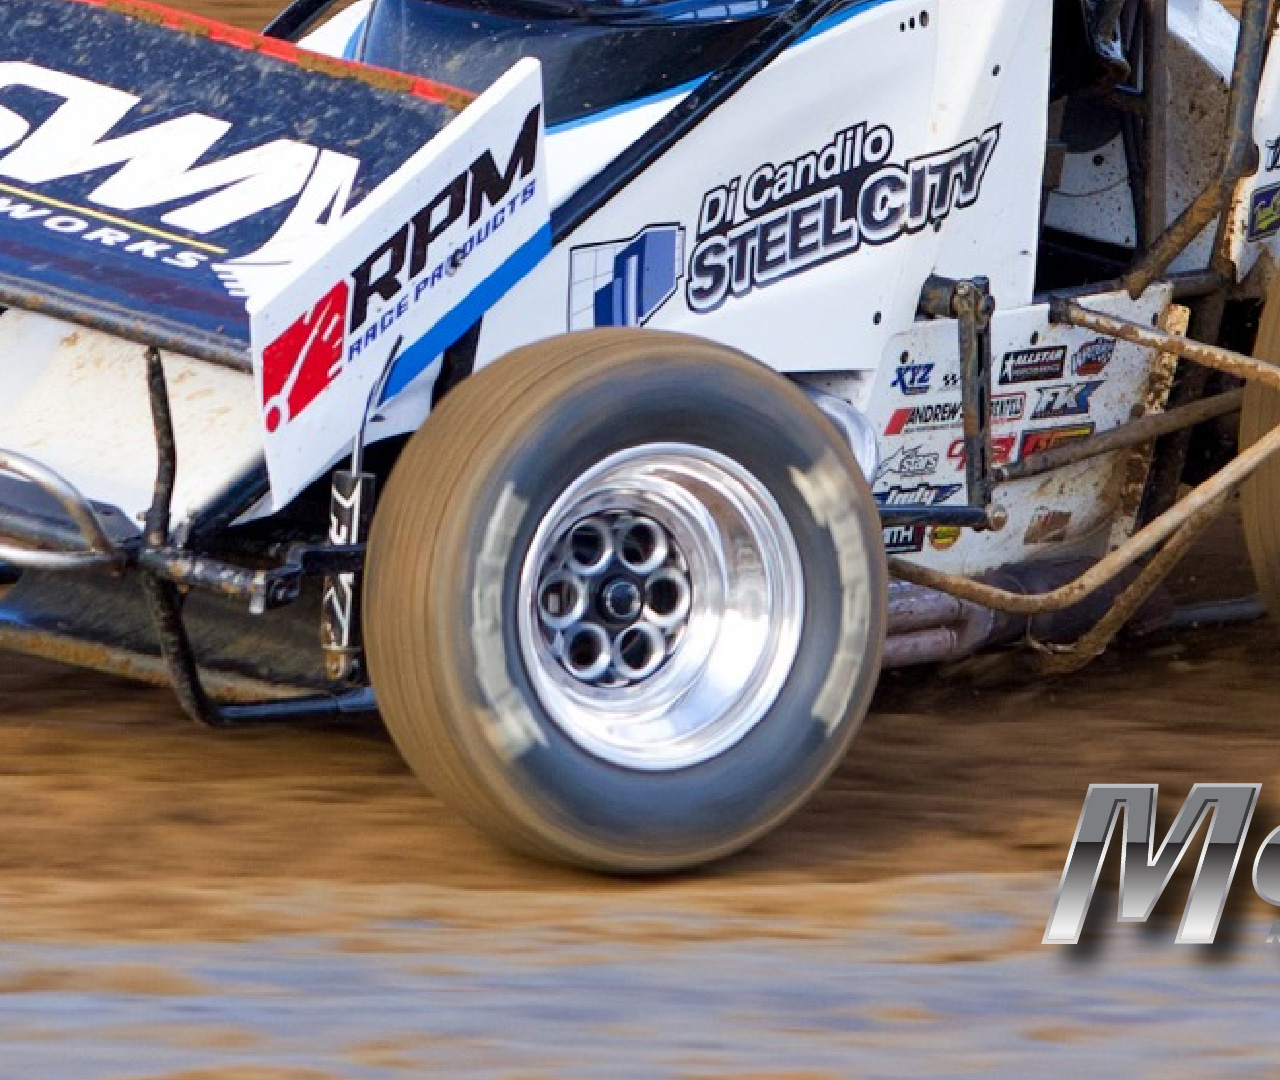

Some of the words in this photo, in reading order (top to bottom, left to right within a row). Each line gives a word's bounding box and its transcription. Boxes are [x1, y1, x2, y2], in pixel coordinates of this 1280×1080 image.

[744, 121, 892, 211] Candilo
[350, 104, 540, 335] RPM
[348, 294, 408, 362] RACE
